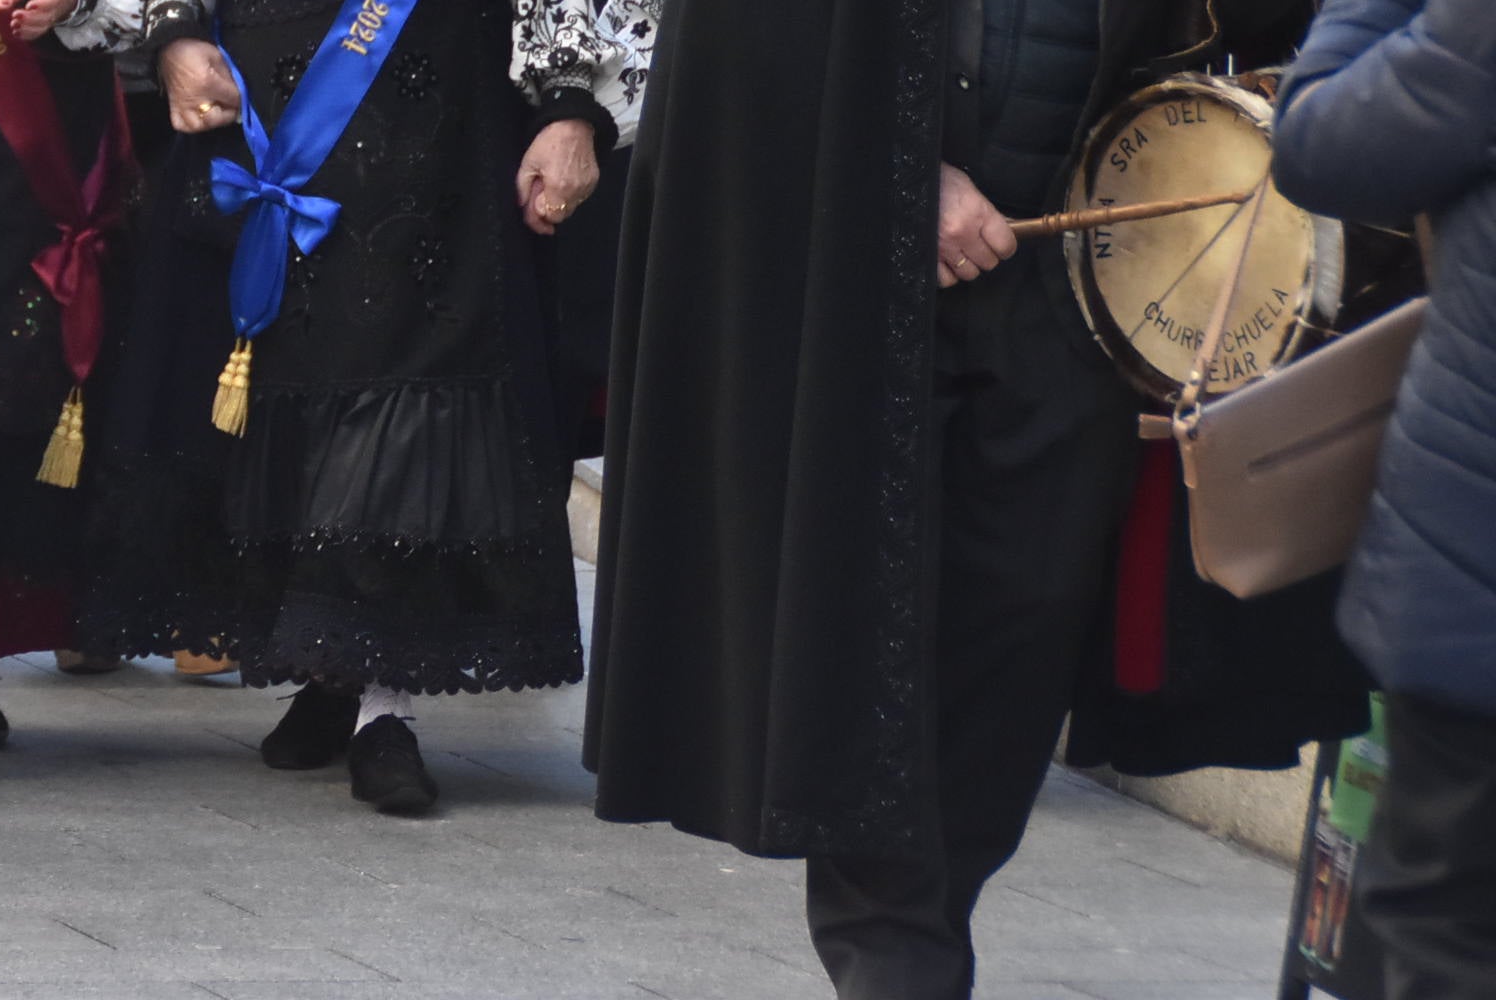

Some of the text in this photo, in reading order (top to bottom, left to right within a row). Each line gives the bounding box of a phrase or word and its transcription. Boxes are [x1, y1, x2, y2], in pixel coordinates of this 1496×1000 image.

[1110, 127, 1149, 173] SRA
[1164, 101, 1207, 127] DEL
[1206, 351, 1258, 383] EJAR
